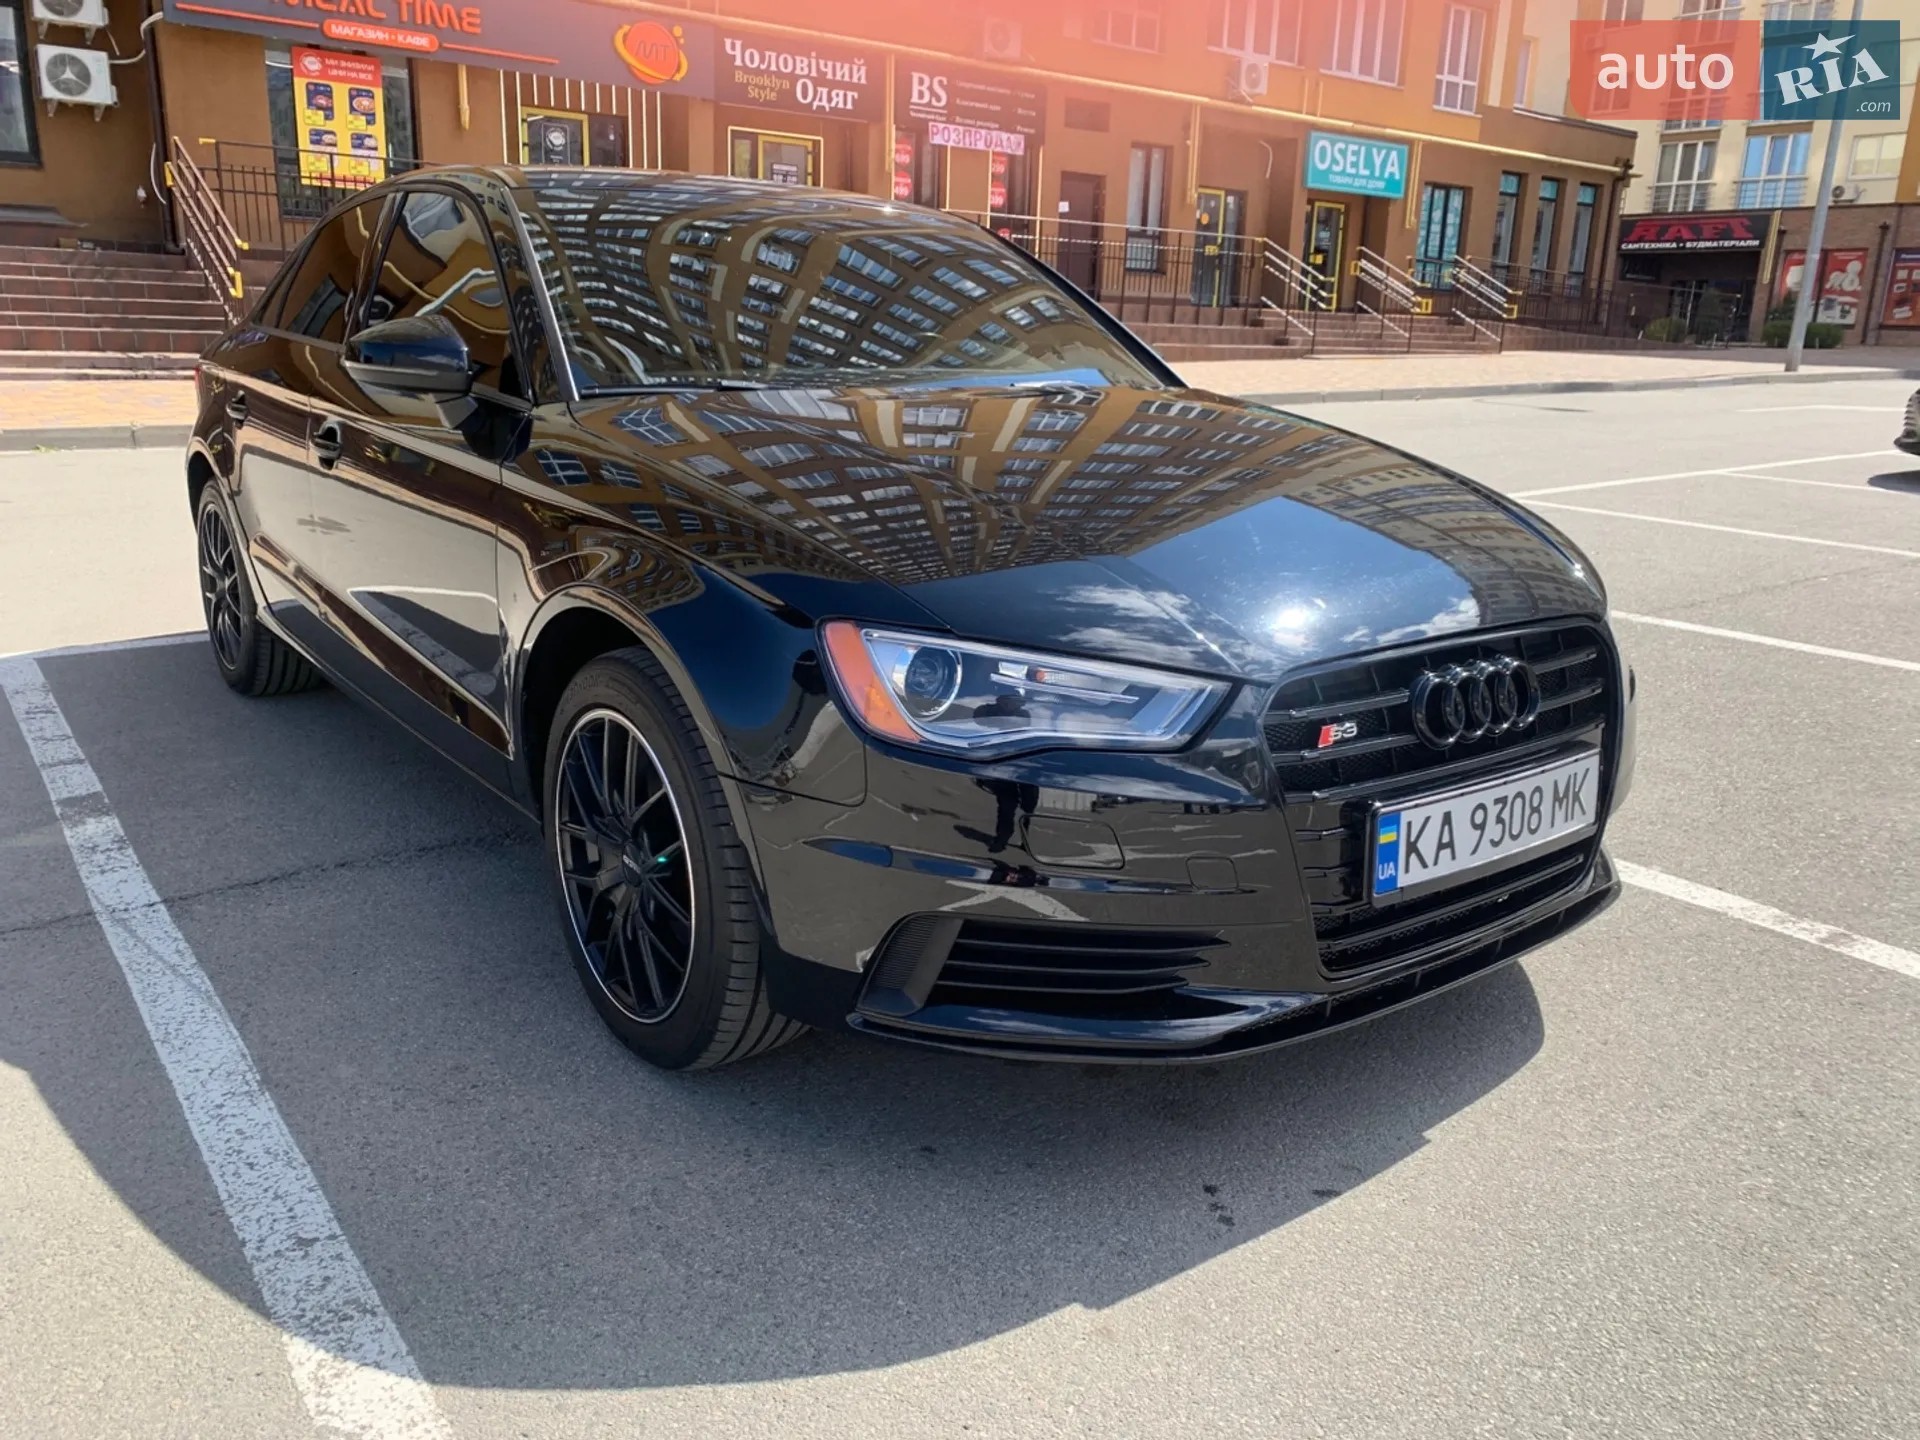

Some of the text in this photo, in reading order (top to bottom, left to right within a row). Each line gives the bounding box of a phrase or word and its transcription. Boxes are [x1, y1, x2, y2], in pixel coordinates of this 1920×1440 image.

[398, 0, 481, 34] TIME
[330, 24, 431, 48] МАГАЗИН КАФЕ
[723, 37, 868, 85] Чоловічий
[734, 70, 791, 91] Brooklyn
[747, 86, 778, 103] Style
[795, 78, 859, 112] Одяг
[910, 71, 948, 108] BS
[1313, 138, 1401, 181] OSELYA
[1621, 239, 1760, 250] САНТЕХНІКА БУДМАТЕРІАЛИ
[1403, 767, 1590, 875] KA 9308 MK
[1377, 861, 1397, 881] UA
